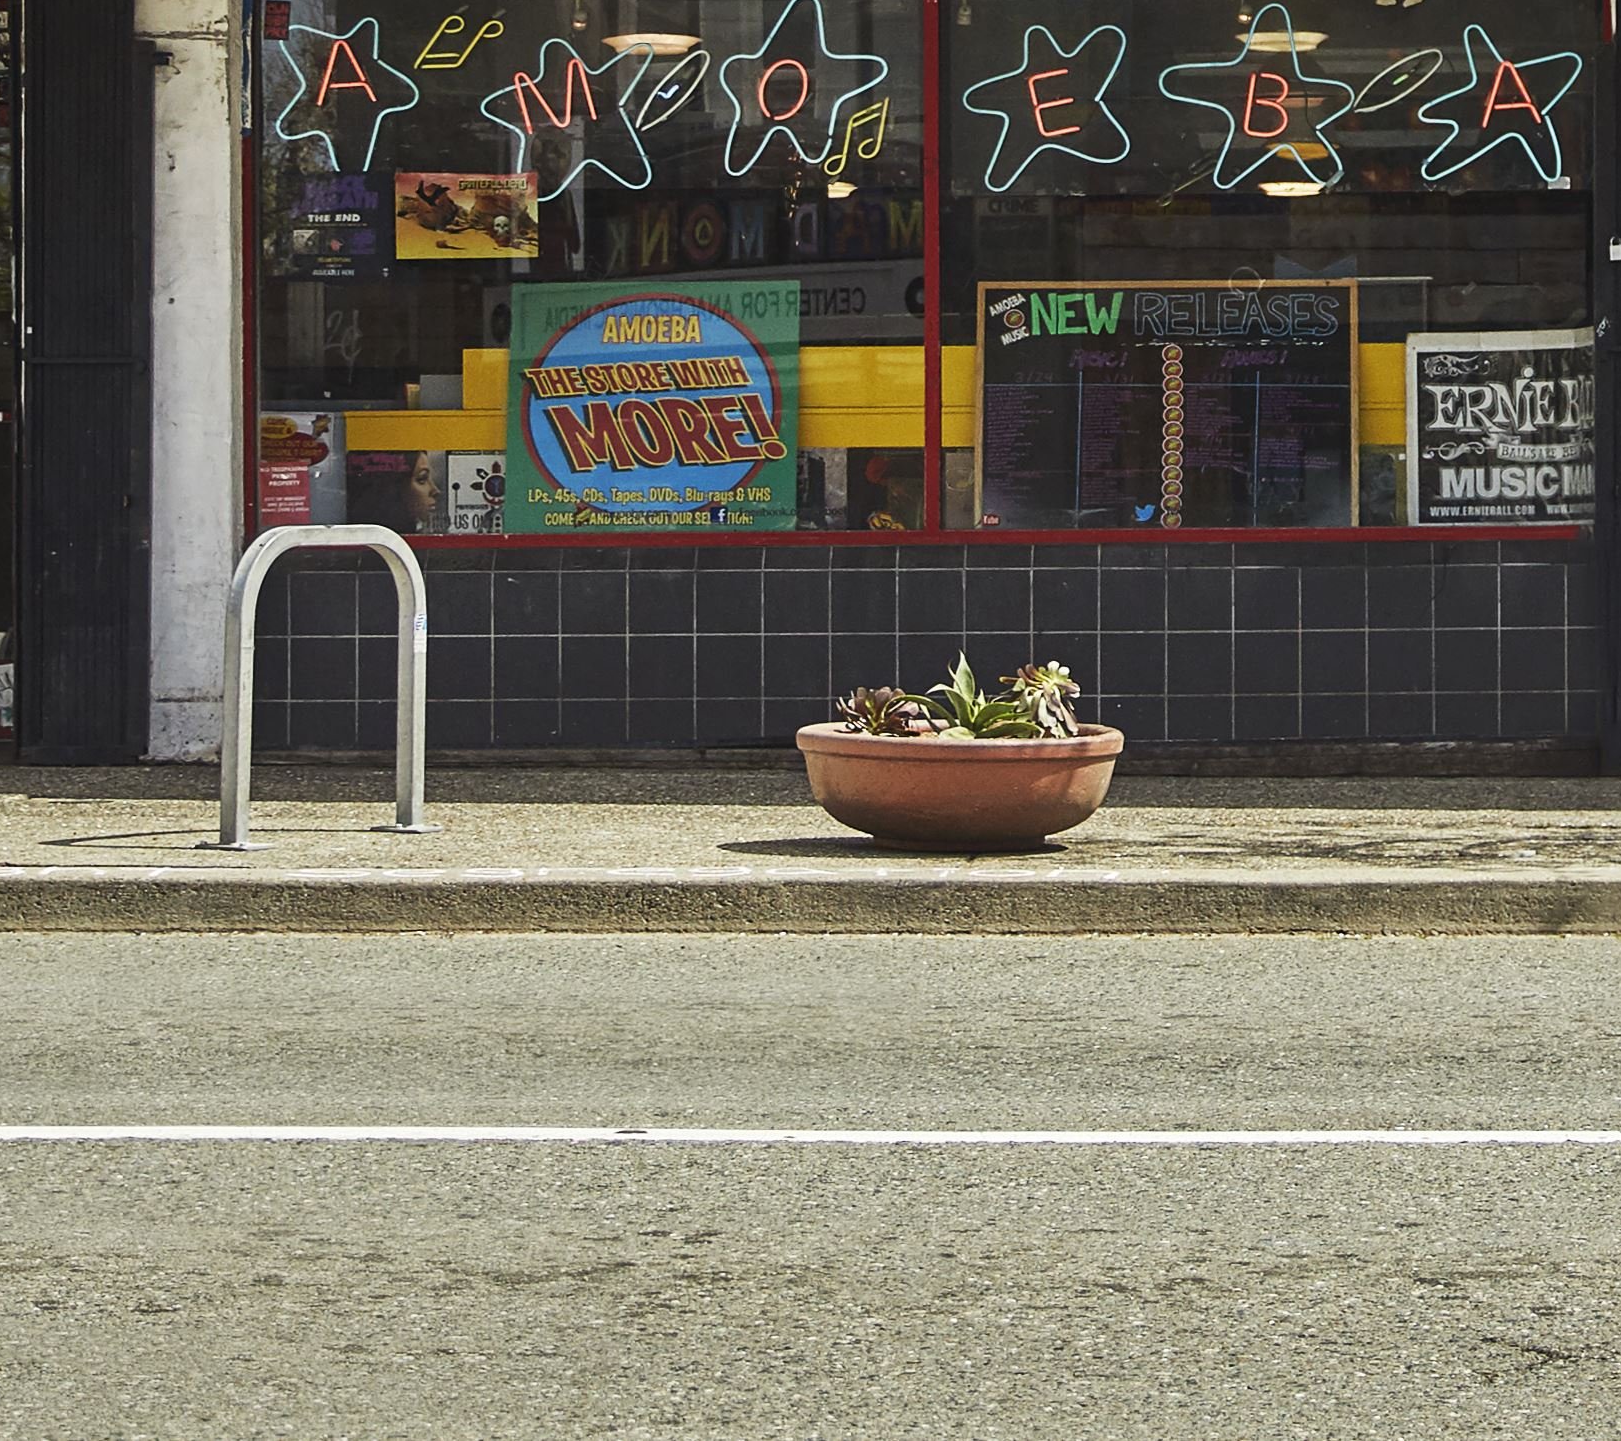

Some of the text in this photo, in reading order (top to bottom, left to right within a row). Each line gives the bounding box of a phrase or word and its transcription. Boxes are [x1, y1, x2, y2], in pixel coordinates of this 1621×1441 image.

[308, 213, 361, 223] THE END
[988, 292, 1028, 318] AMOEBA
[1030, 291, 1340, 337] NEW RELEASES
[602, 315, 702, 344] AMOEBA
[1001, 326, 1030, 347] MUSIC
[524, 355, 754, 399] THE STORE WITH
[545, 393, 788, 472] MORE!
[1440, 465, 1559, 499] MUSIC
[528, 488, 553, 505] LPs,
[555, 488, 580, 504] 45s,
[582, 487, 608, 504] CDs,
[611, 487, 647, 506] Tapes,
[649, 487, 683, 505] DVDs,
[736, 487, 745, 502] &
[747, 487, 771, 502] VHS
[454, 513, 469, 530] US
[544, 512, 574, 526] COME
[589, 512, 611, 525] AND
[671, 512, 694, 525] OUR
[695, 511, 754, 525] SELTION!
[1429, 505, 1536, 517] WWW.ERNIEBALL.COM
